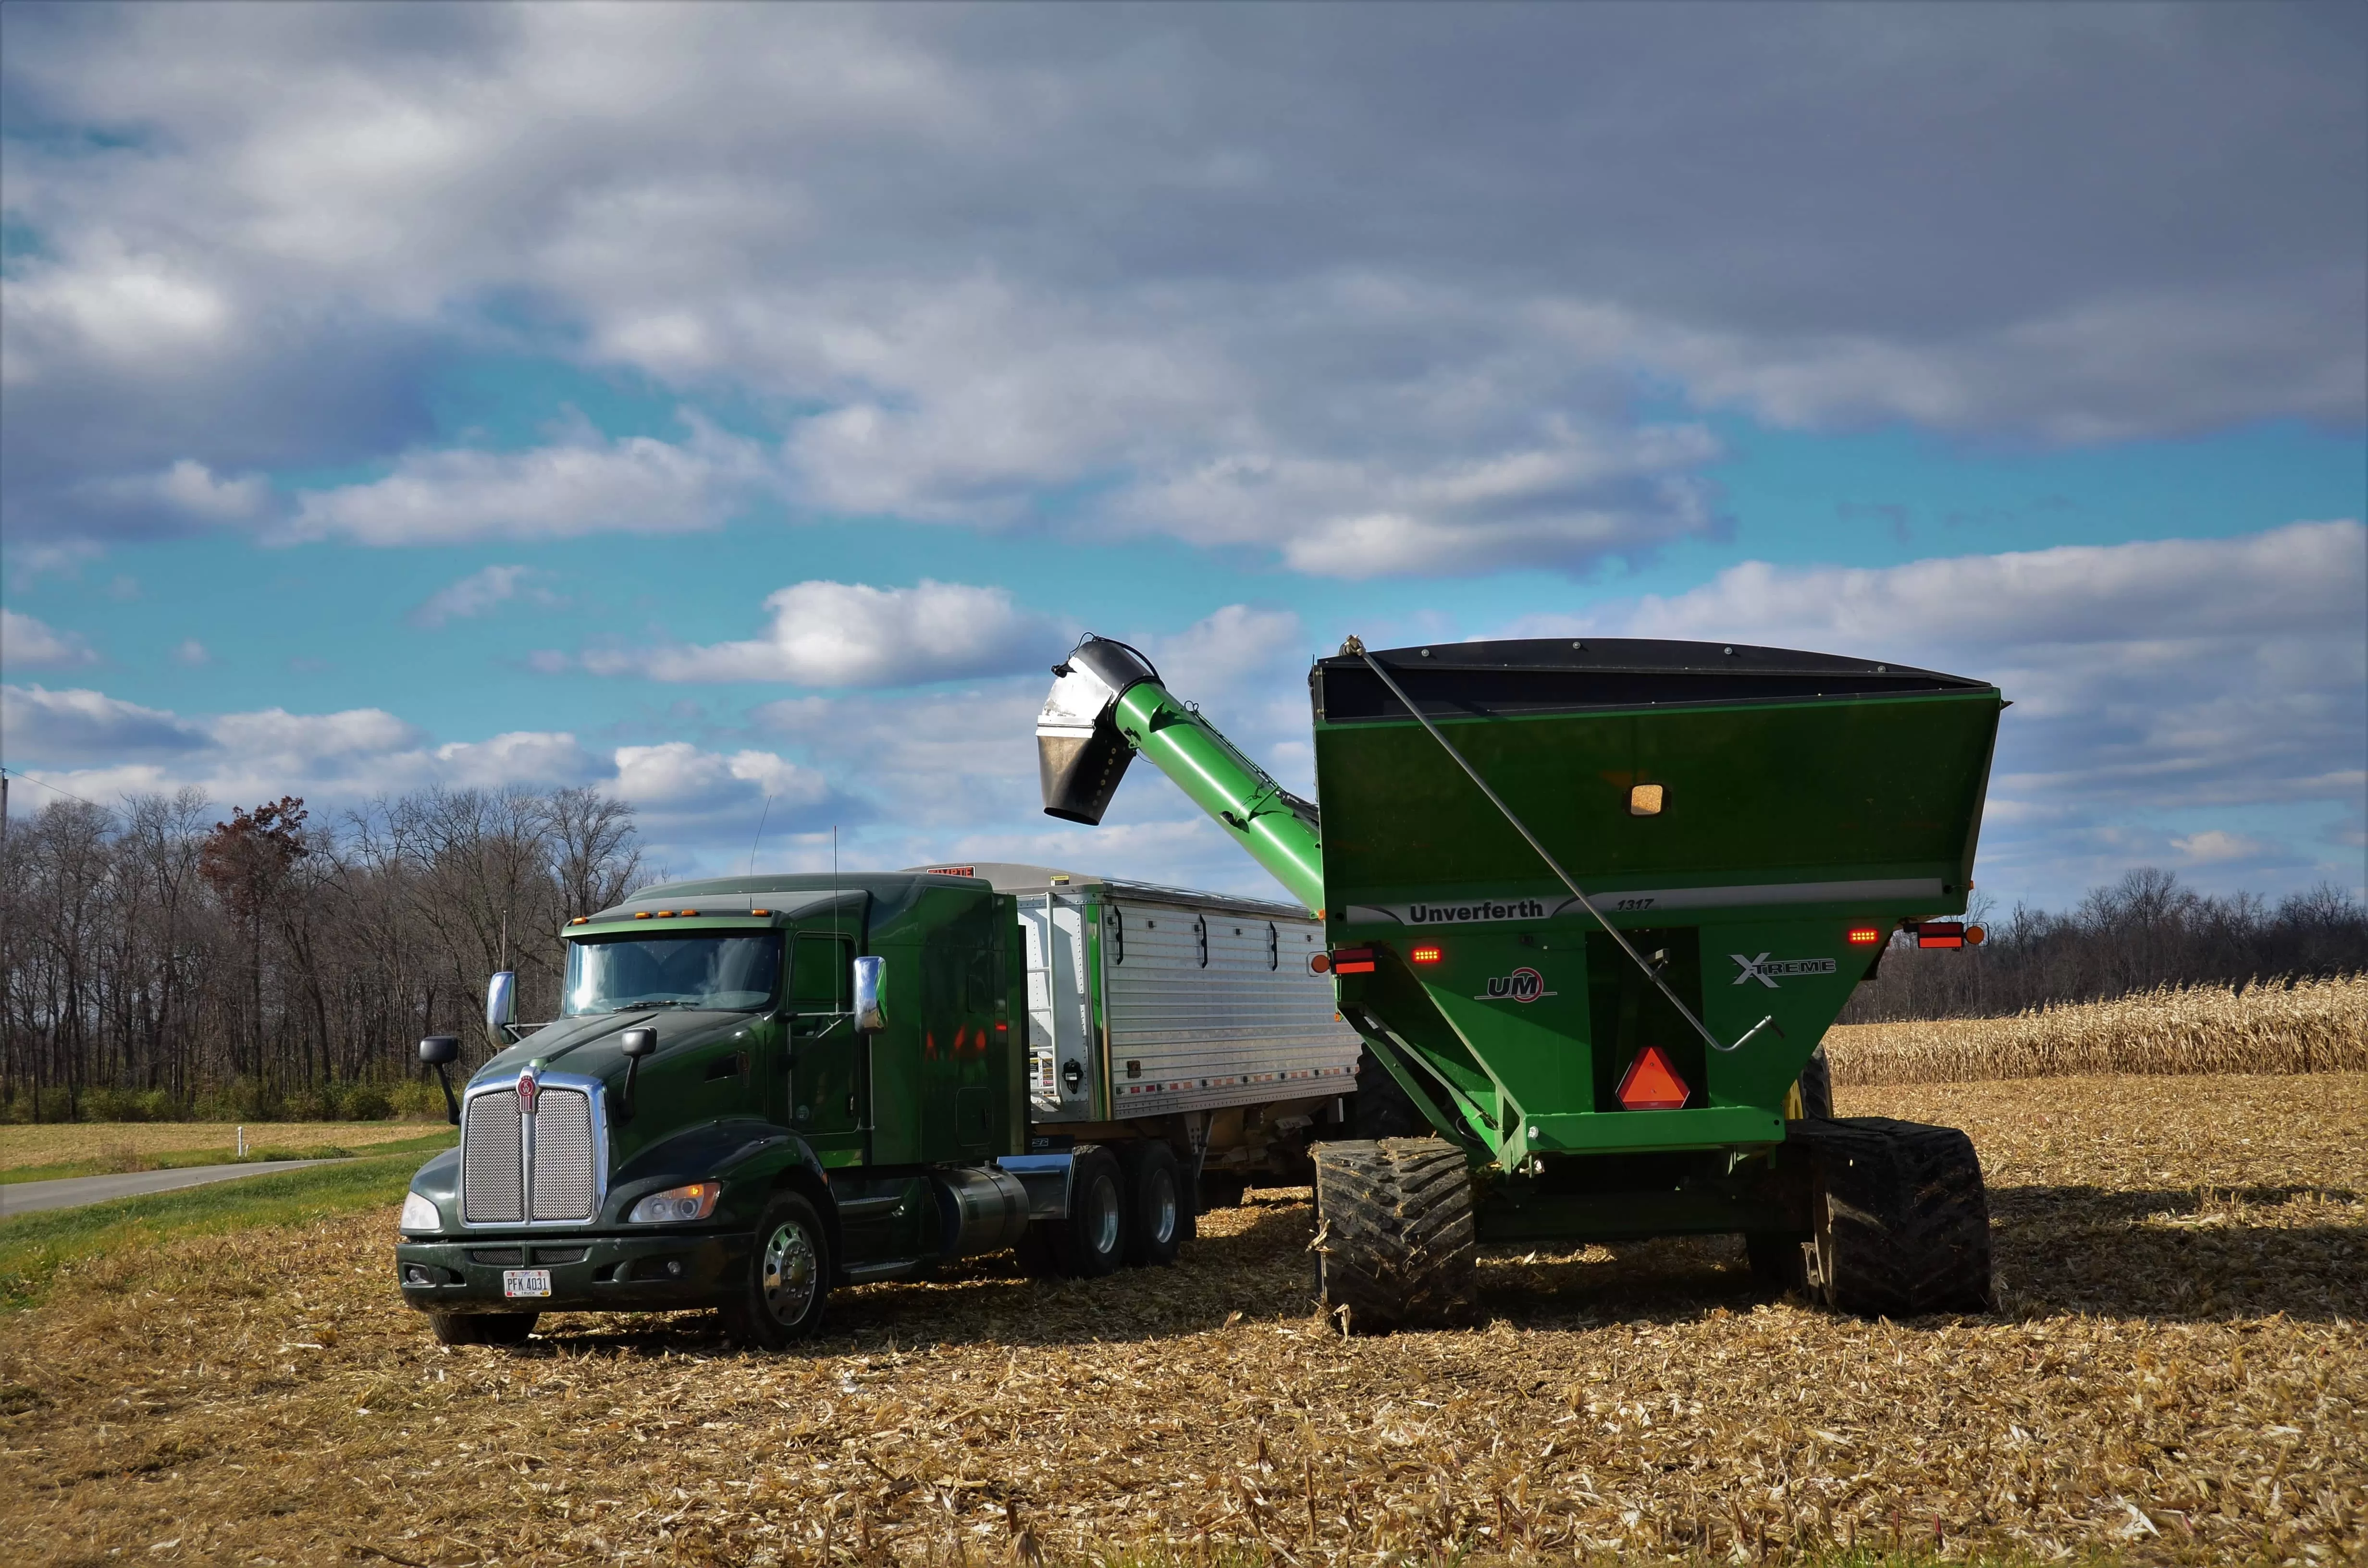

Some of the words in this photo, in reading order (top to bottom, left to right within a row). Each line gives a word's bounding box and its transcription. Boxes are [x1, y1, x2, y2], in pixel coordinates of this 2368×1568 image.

[1410, 900, 1543, 923] Unverferth
[1617, 898, 1654, 911] 1317
[1727, 952, 1836, 988] XTREME
[1488, 976, 1539, 996] UM
[507, 1278, 524, 1291] PFK
[527, 1278, 547, 1290] 4031
